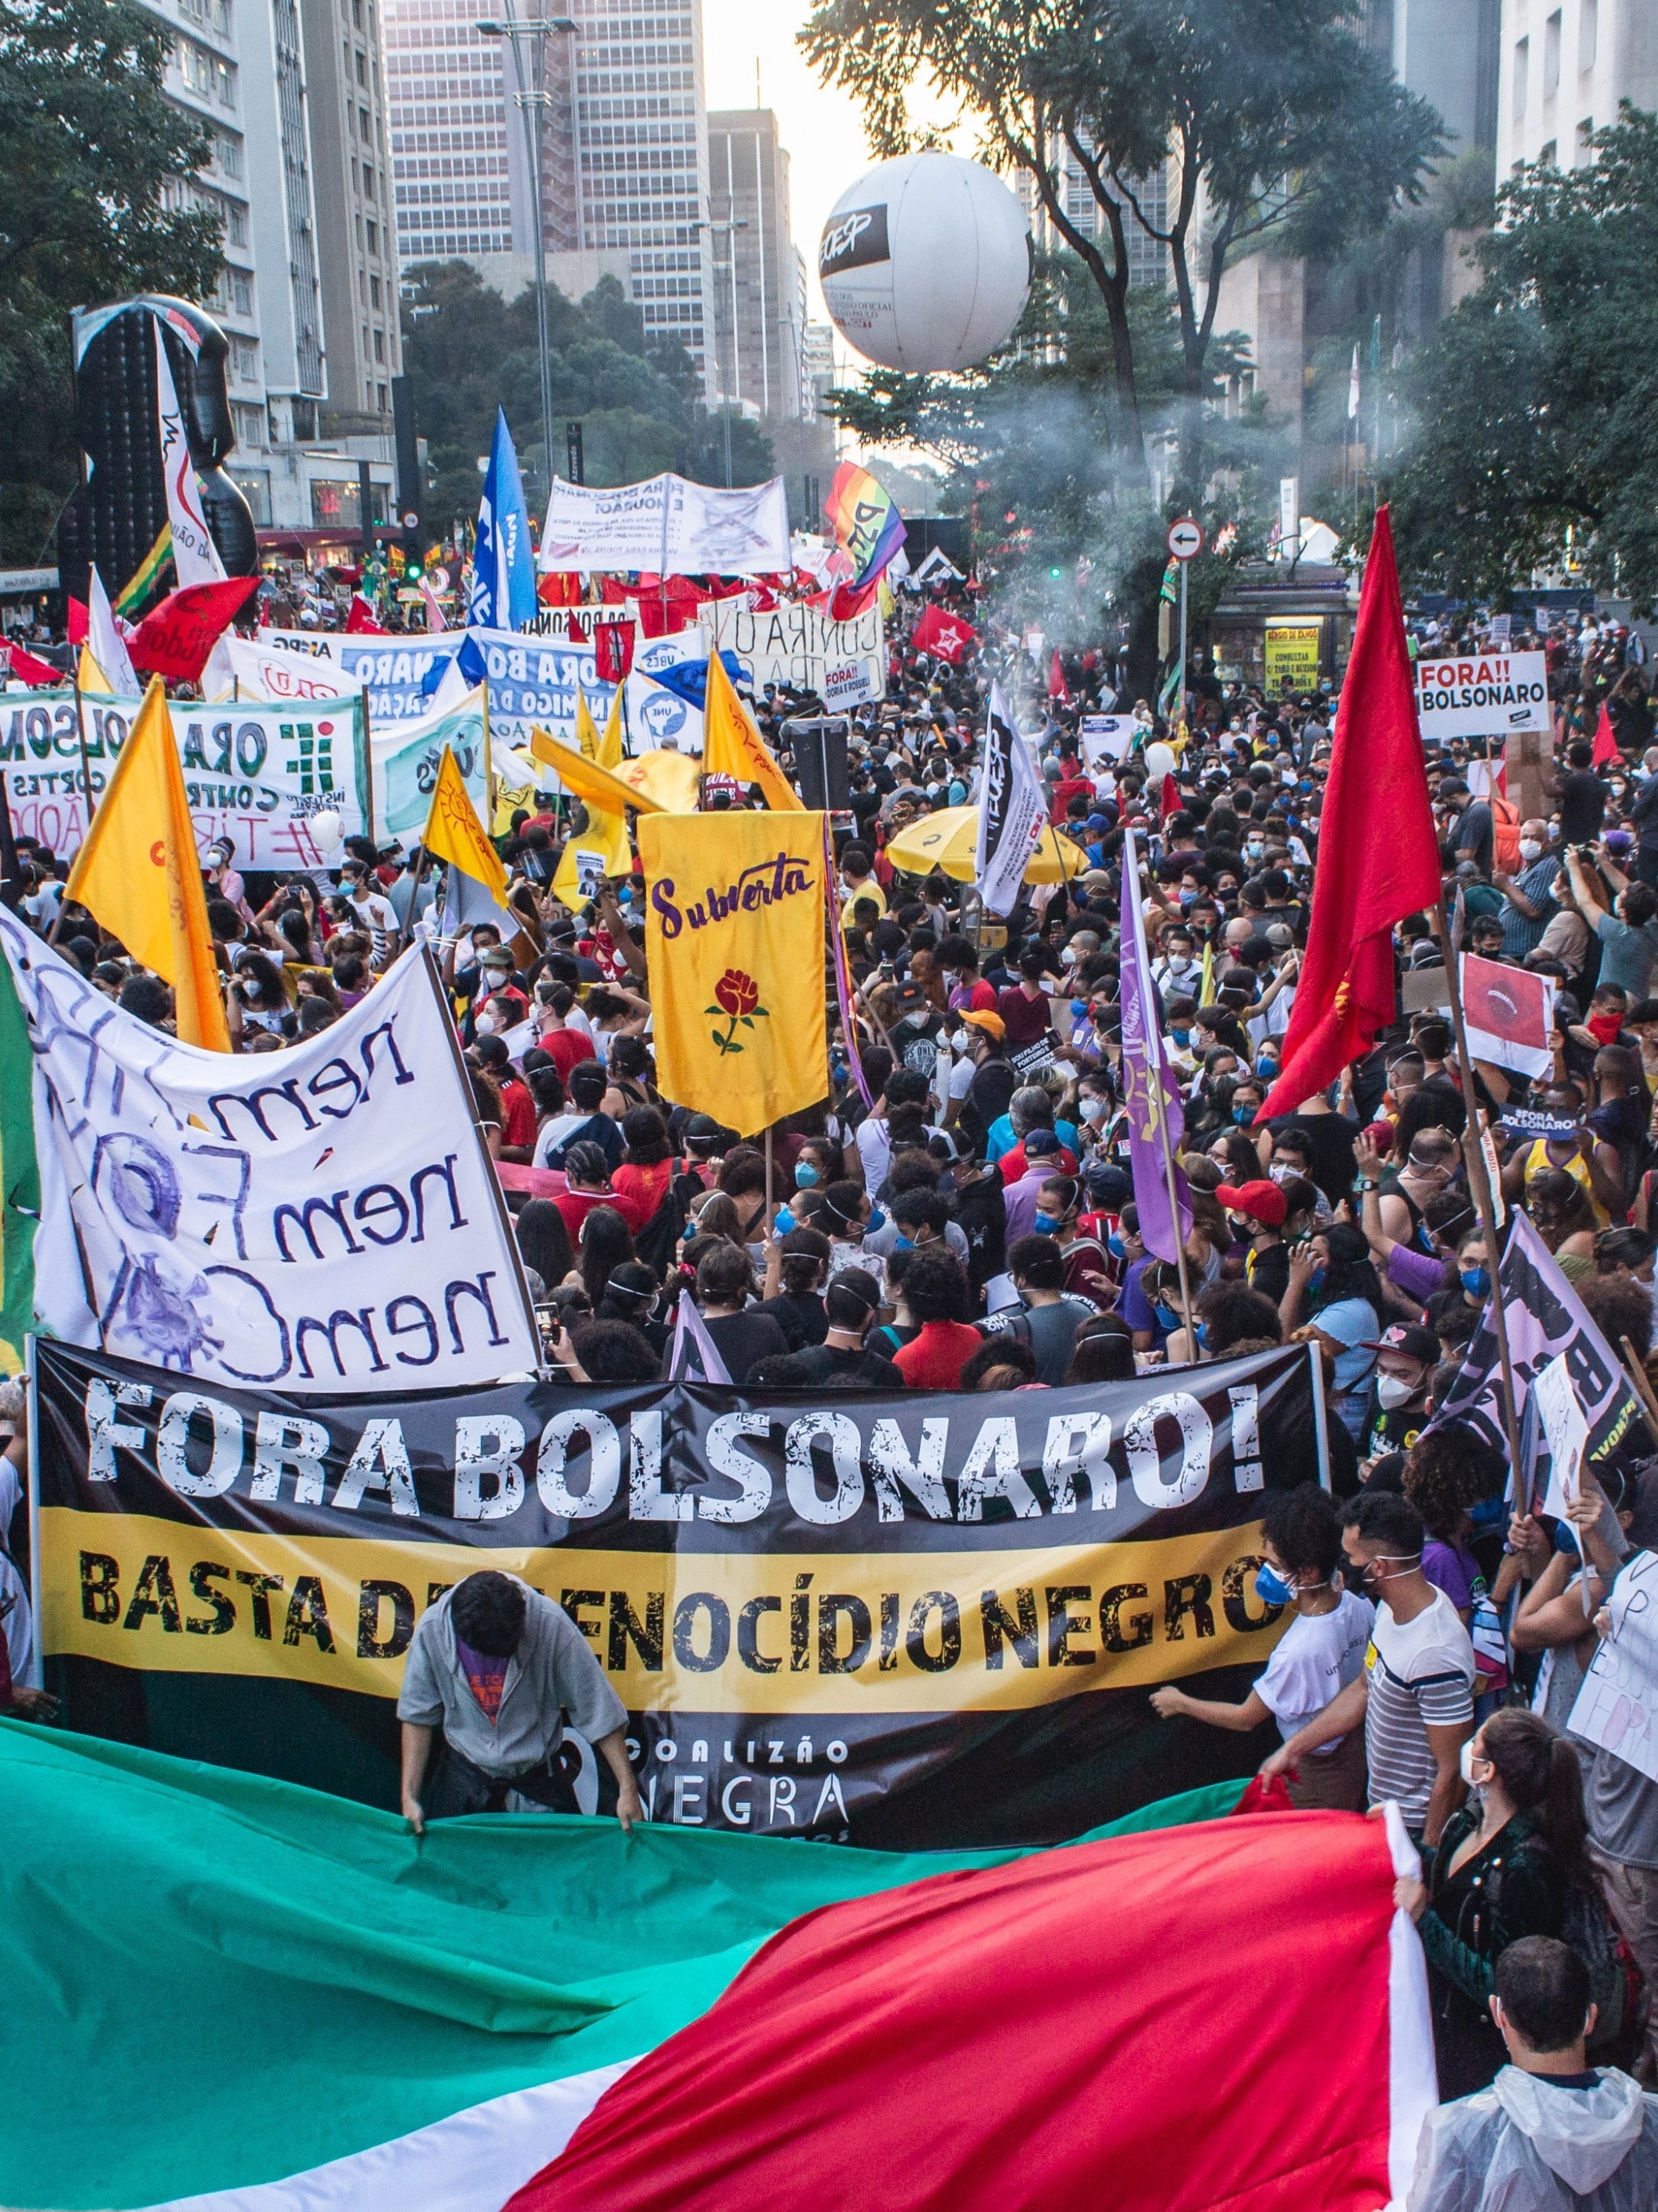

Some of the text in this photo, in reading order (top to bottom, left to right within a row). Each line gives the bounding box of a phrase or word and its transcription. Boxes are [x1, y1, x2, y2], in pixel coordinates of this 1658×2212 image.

[943, 633, 957, 645] PT
[1275, 653, 1309, 662] CONSULTAS
[825, 666, 859, 688] FORA!!
[1420, 659, 1510, 689] FORA!!
[826, 683, 844, 699] DORIA
[1423, 683, 1544, 711] BOLSONARO
[652, 852, 815, 939] Subverta
[917, 1046, 937, 1057] ONLY
[1023, 1042, 1041, 1056] FILHO
[1040, 1037, 1050, 1046] DE
[1017, 1048, 1046, 1068] PORTEIRO
[1501, 1114, 1577, 1130] BOLSONARO!
[1515, 1109, 1554, 1122] #FORA
[1486, 1149, 1497, 1173] BOZO
[84, 1376, 1265, 1525] FORA BOLSONARO!
[80, 1549, 338, 1655] BASTA
[560, 1573, 963, 1674] ENOCÍDIO
[980, 1554, 1287, 1672] NEGRO
[625, 1736, 848, 1764] COALIZÃO
